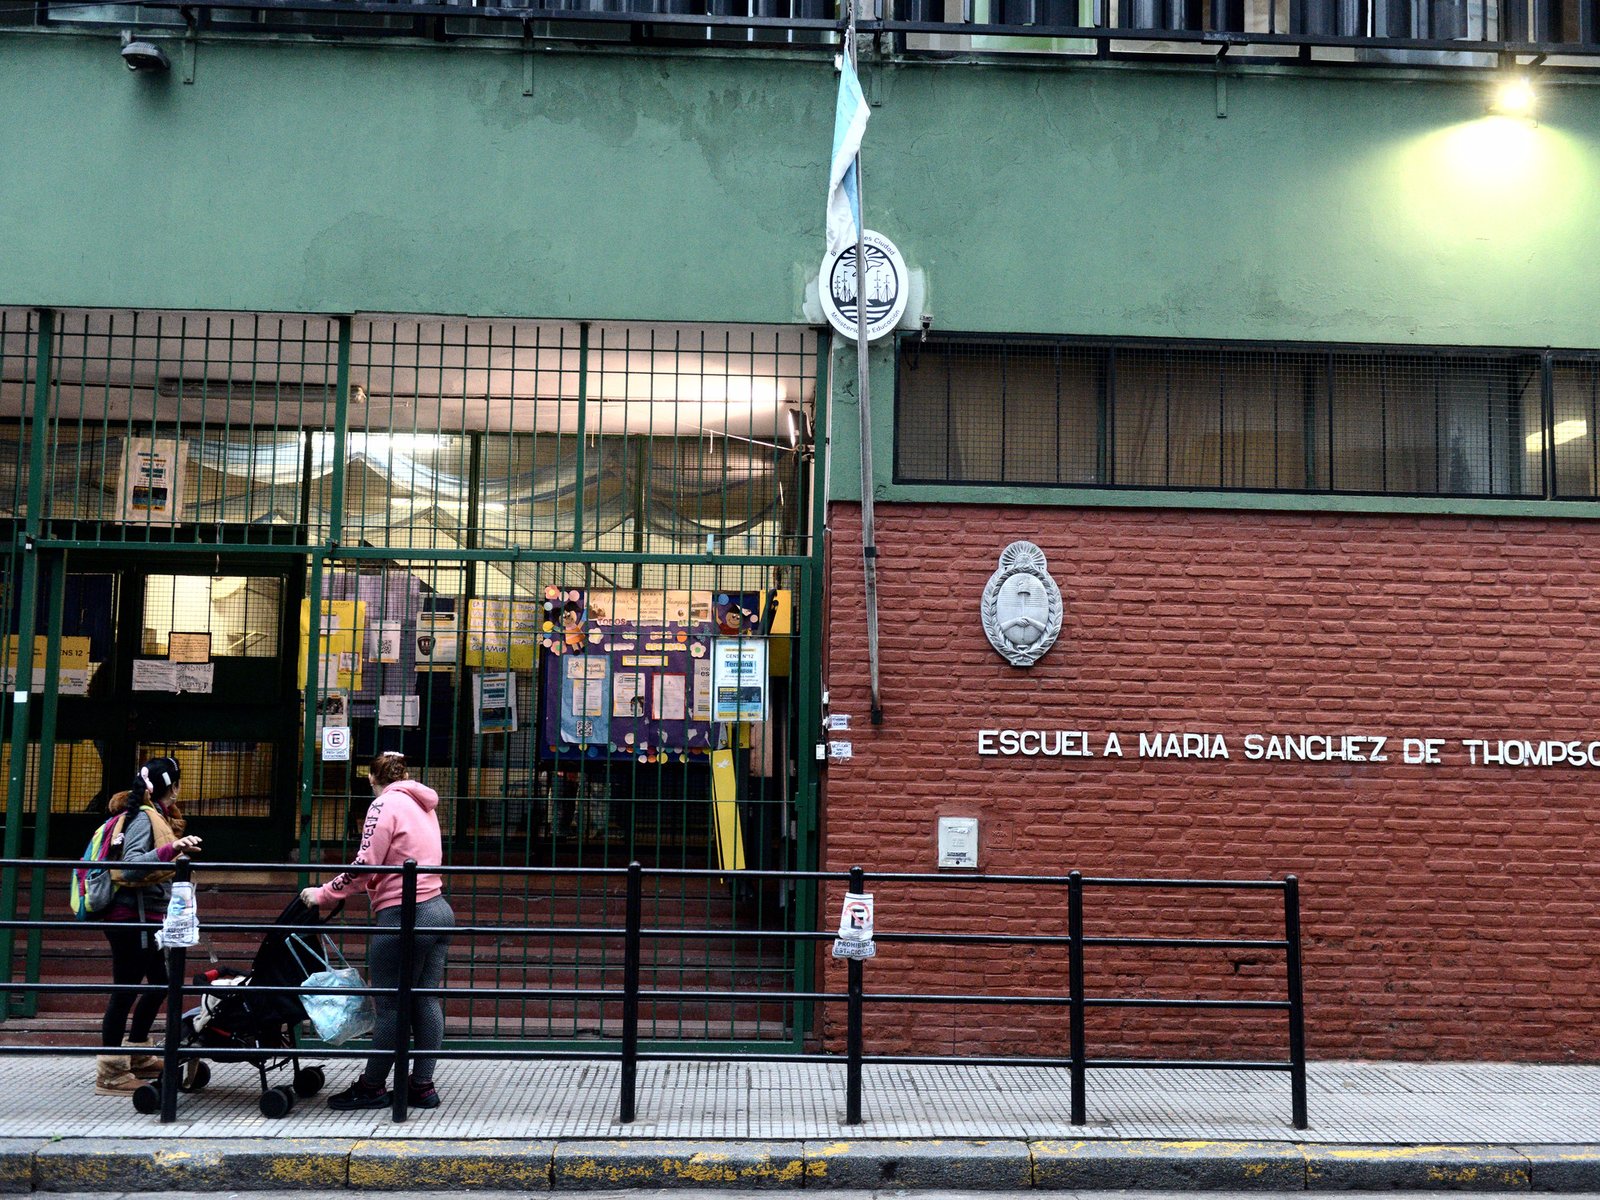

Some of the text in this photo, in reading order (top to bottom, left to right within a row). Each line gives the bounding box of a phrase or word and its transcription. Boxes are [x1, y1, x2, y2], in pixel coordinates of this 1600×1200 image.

[873, 237, 896, 256] Ciudad
[871, 309, 900, 333] Educación
[75, 649, 83, 657] 12
[725, 660, 753, 668] Teriná
[1138, 732, 1229, 760] MARIA
[1243, 734, 1388, 763] SANCHEZ
[1402, 738, 1446, 764] DE
